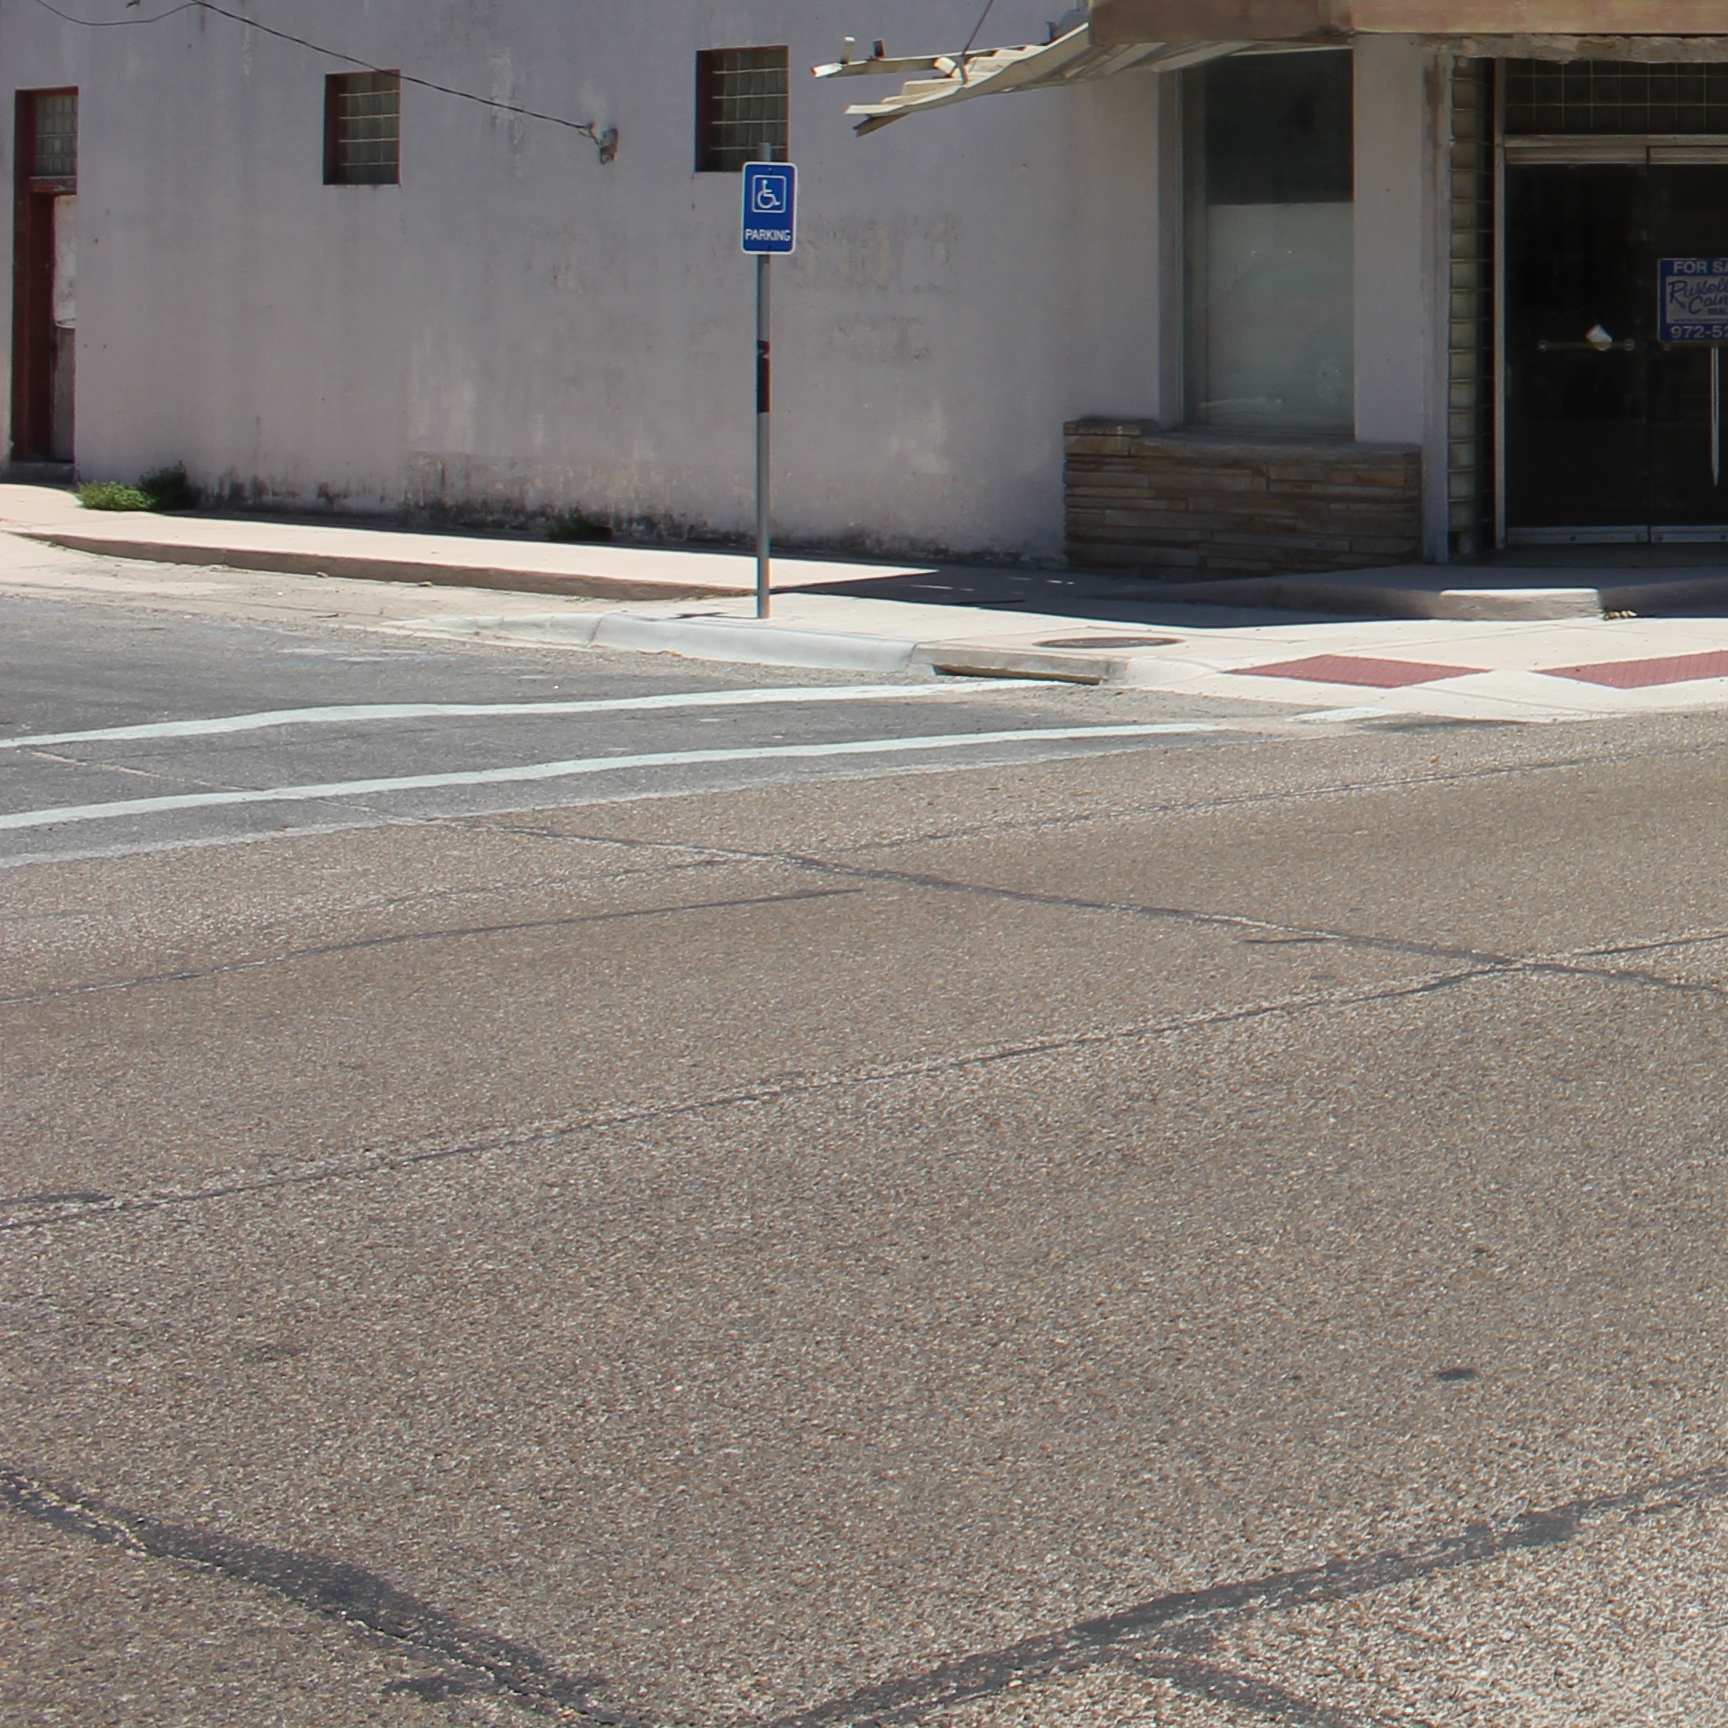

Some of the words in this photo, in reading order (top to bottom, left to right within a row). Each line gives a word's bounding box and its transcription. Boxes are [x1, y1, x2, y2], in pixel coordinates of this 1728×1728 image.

[745, 229, 791, 241] PARKING
[1673, 261, 1708, 273] FOR
[1688, 294, 1728, 314] Cain
